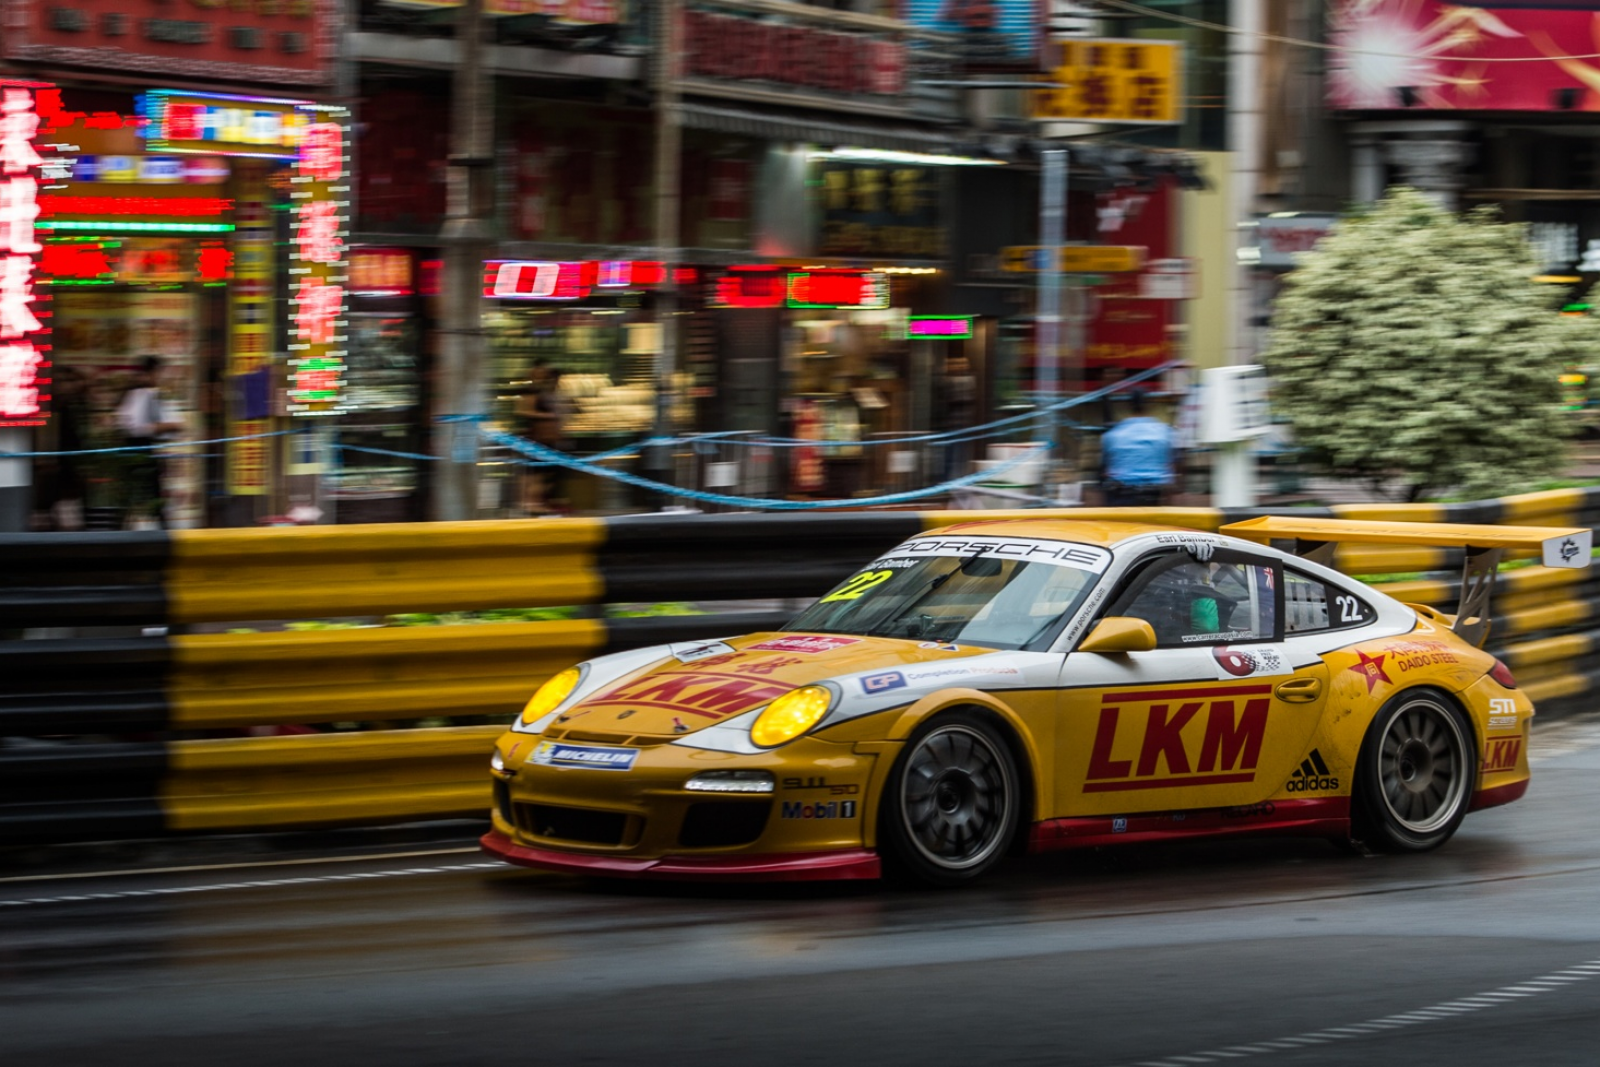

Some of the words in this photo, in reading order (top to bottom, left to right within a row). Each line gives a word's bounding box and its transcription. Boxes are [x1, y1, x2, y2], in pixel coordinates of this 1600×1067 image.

[1156, 534, 1177, 543] Earl
[892, 540, 1101, 566] PORSCHE
[819, 570, 893, 603] 22
[1066, 587, 1105, 641] www.porsche.com
[1336, 596, 1363, 622] 22
[1398, 656, 1430, 672] DAIDO
[1431, 653, 1459, 664] STEEL
[596, 675, 790, 714] LKM
[1086, 699, 1271, 780] LKM
[553, 750, 635, 763] MICHELIN
[1482, 740, 1521, 769] LKM
[1286, 775, 1339, 792] adidas
[782, 801, 838, 818] Mobil
[842, 801, 854, 818] 1
